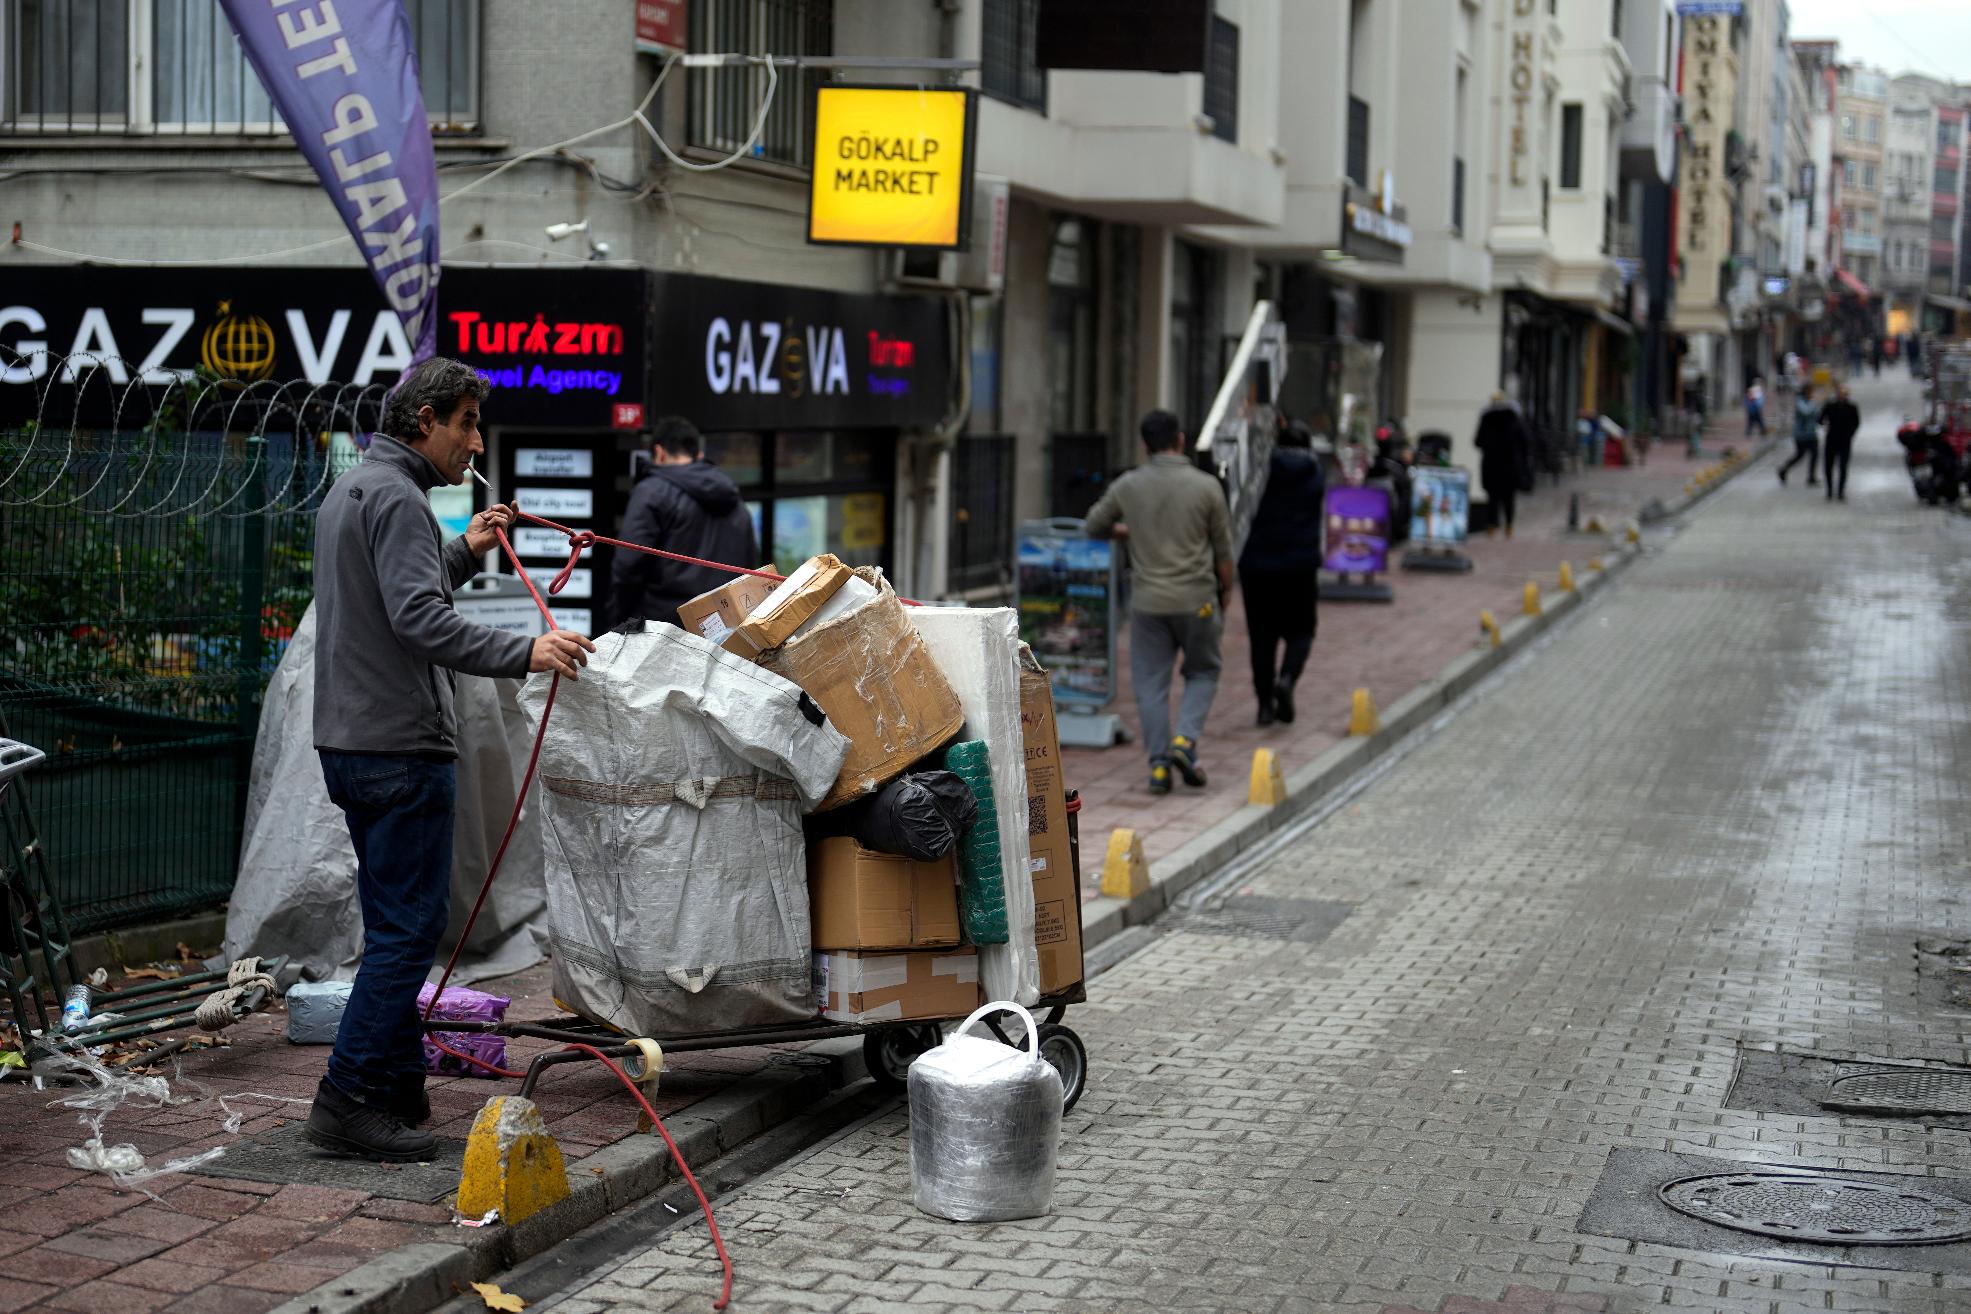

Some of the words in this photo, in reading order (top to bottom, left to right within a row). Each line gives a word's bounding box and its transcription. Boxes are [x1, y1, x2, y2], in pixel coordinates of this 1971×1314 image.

[1511, 32, 1533, 187] HOTEL
[838, 130, 941, 163] GÖKALP
[833, 168, 942, 196] MARKET
[527, 364, 622, 396] Agency
